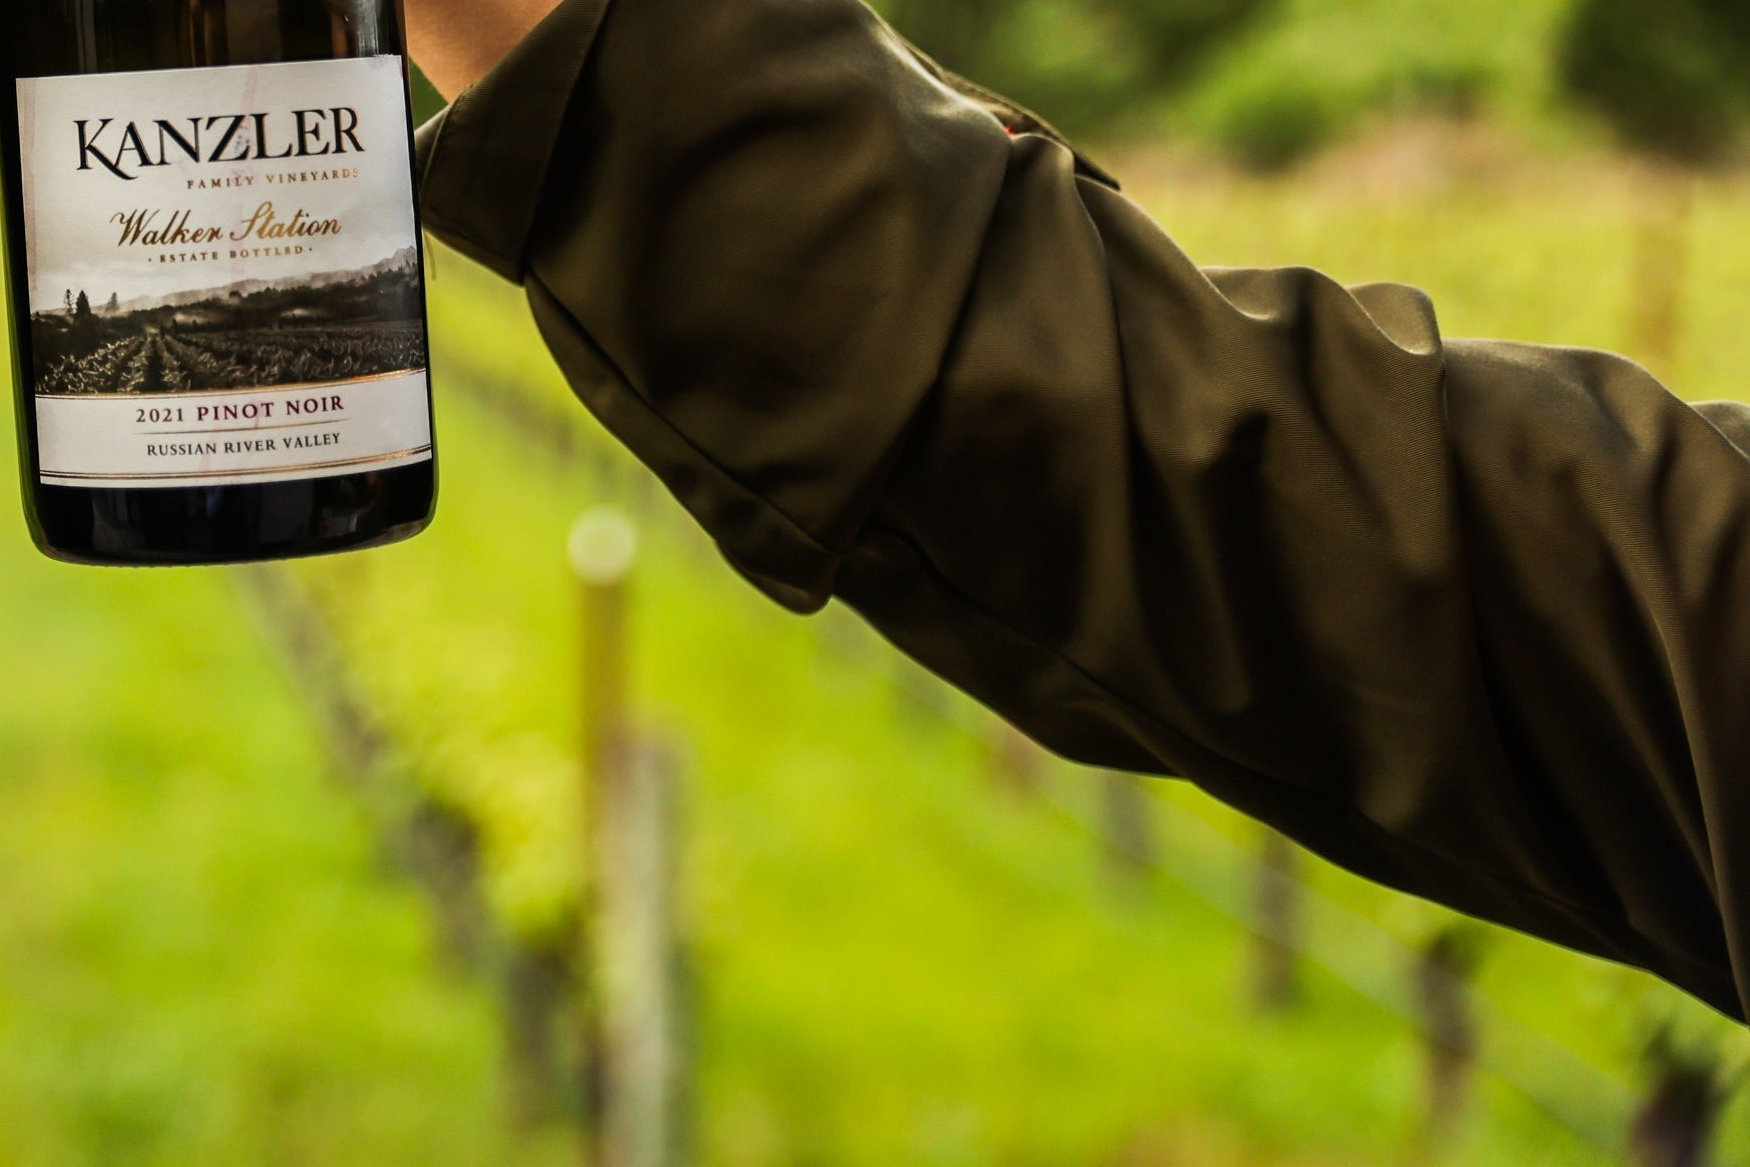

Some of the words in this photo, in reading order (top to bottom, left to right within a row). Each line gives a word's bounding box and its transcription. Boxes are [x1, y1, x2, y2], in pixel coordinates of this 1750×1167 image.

[73, 107, 366, 181] KANZLER
[187, 175, 254, 190] FAMILY
[265, 167, 360, 184] VINEYARDS
[110, 209, 223, 247] Walker
[230, 201, 342, 240] Station
[159, 251, 219, 263] ESTATE
[229, 246, 304, 260] BOTTLED
[136, 408, 184, 423] 2021
[197, 402, 275, 421] PINOT
[286, 395, 344, 415] NOIR
[147, 442, 217, 456] RUSSIAN
[224, 439, 276, 454] RIVER
[282, 433, 340, 449] VALLEY
